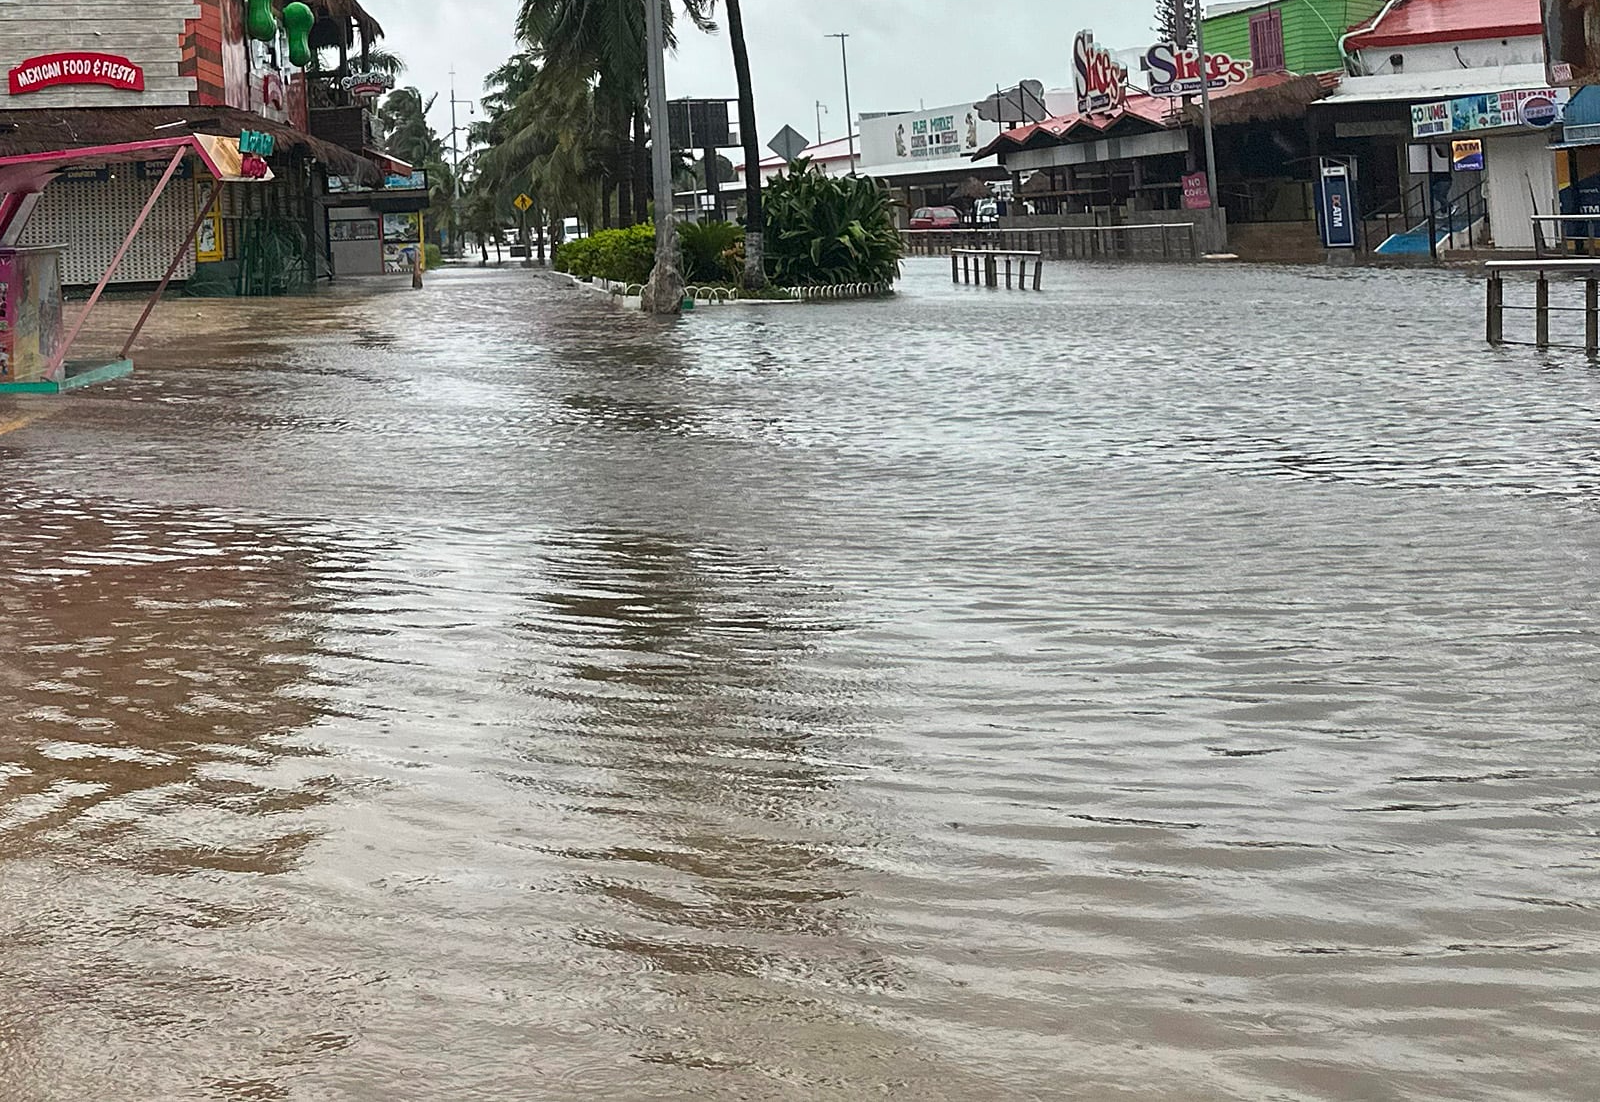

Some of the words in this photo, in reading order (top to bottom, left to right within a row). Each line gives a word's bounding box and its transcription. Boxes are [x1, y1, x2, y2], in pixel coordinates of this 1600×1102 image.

[16, 61, 62, 88] MEXICAN
[62, 59, 91, 76] FOOD
[92, 58, 102, 77] &
[102, 60, 137, 85] FIESTA
[1455, 142, 1480, 152] ATM
[1187, 177, 1201, 187] NO
